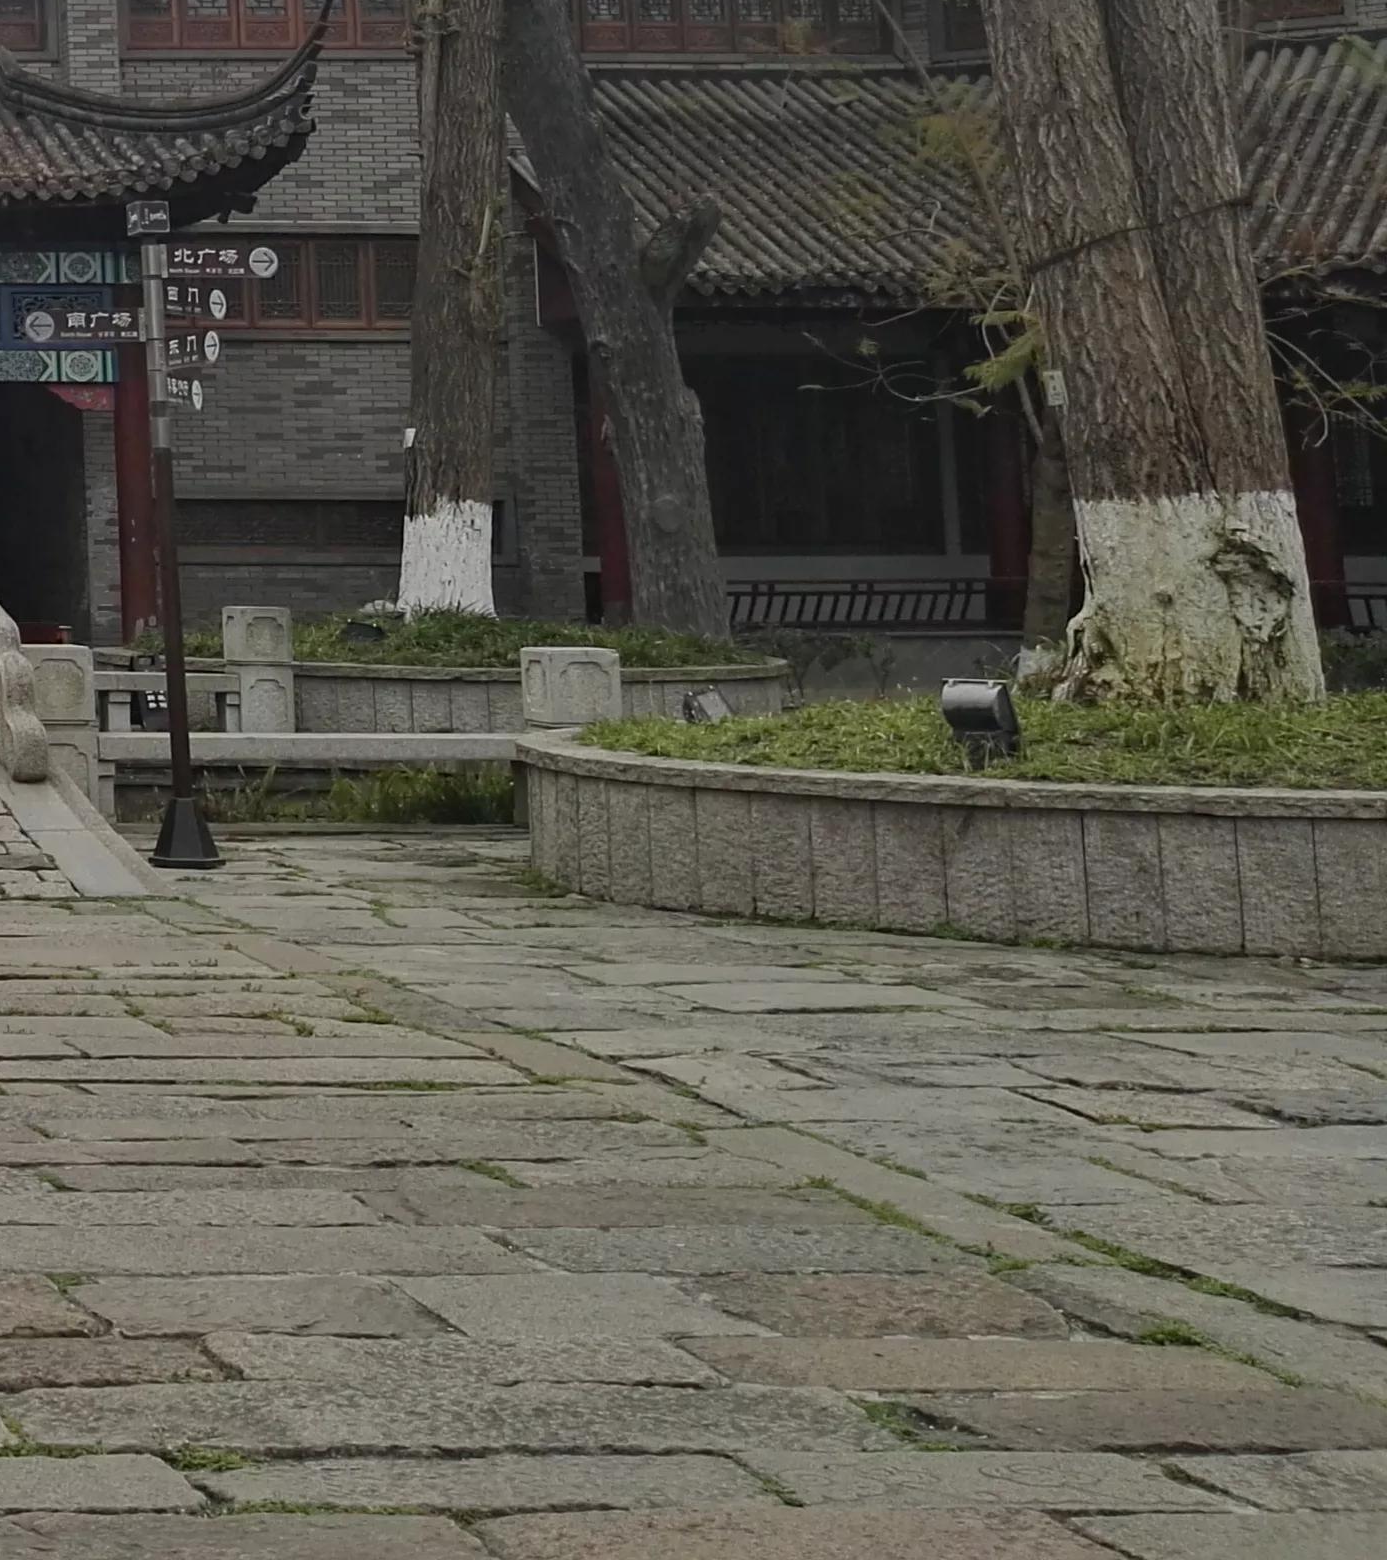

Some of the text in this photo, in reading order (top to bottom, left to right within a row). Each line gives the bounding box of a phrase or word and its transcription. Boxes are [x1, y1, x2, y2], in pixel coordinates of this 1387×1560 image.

[173, 248, 239, 264] 北广场
[66, 312, 132, 328] 南广场
